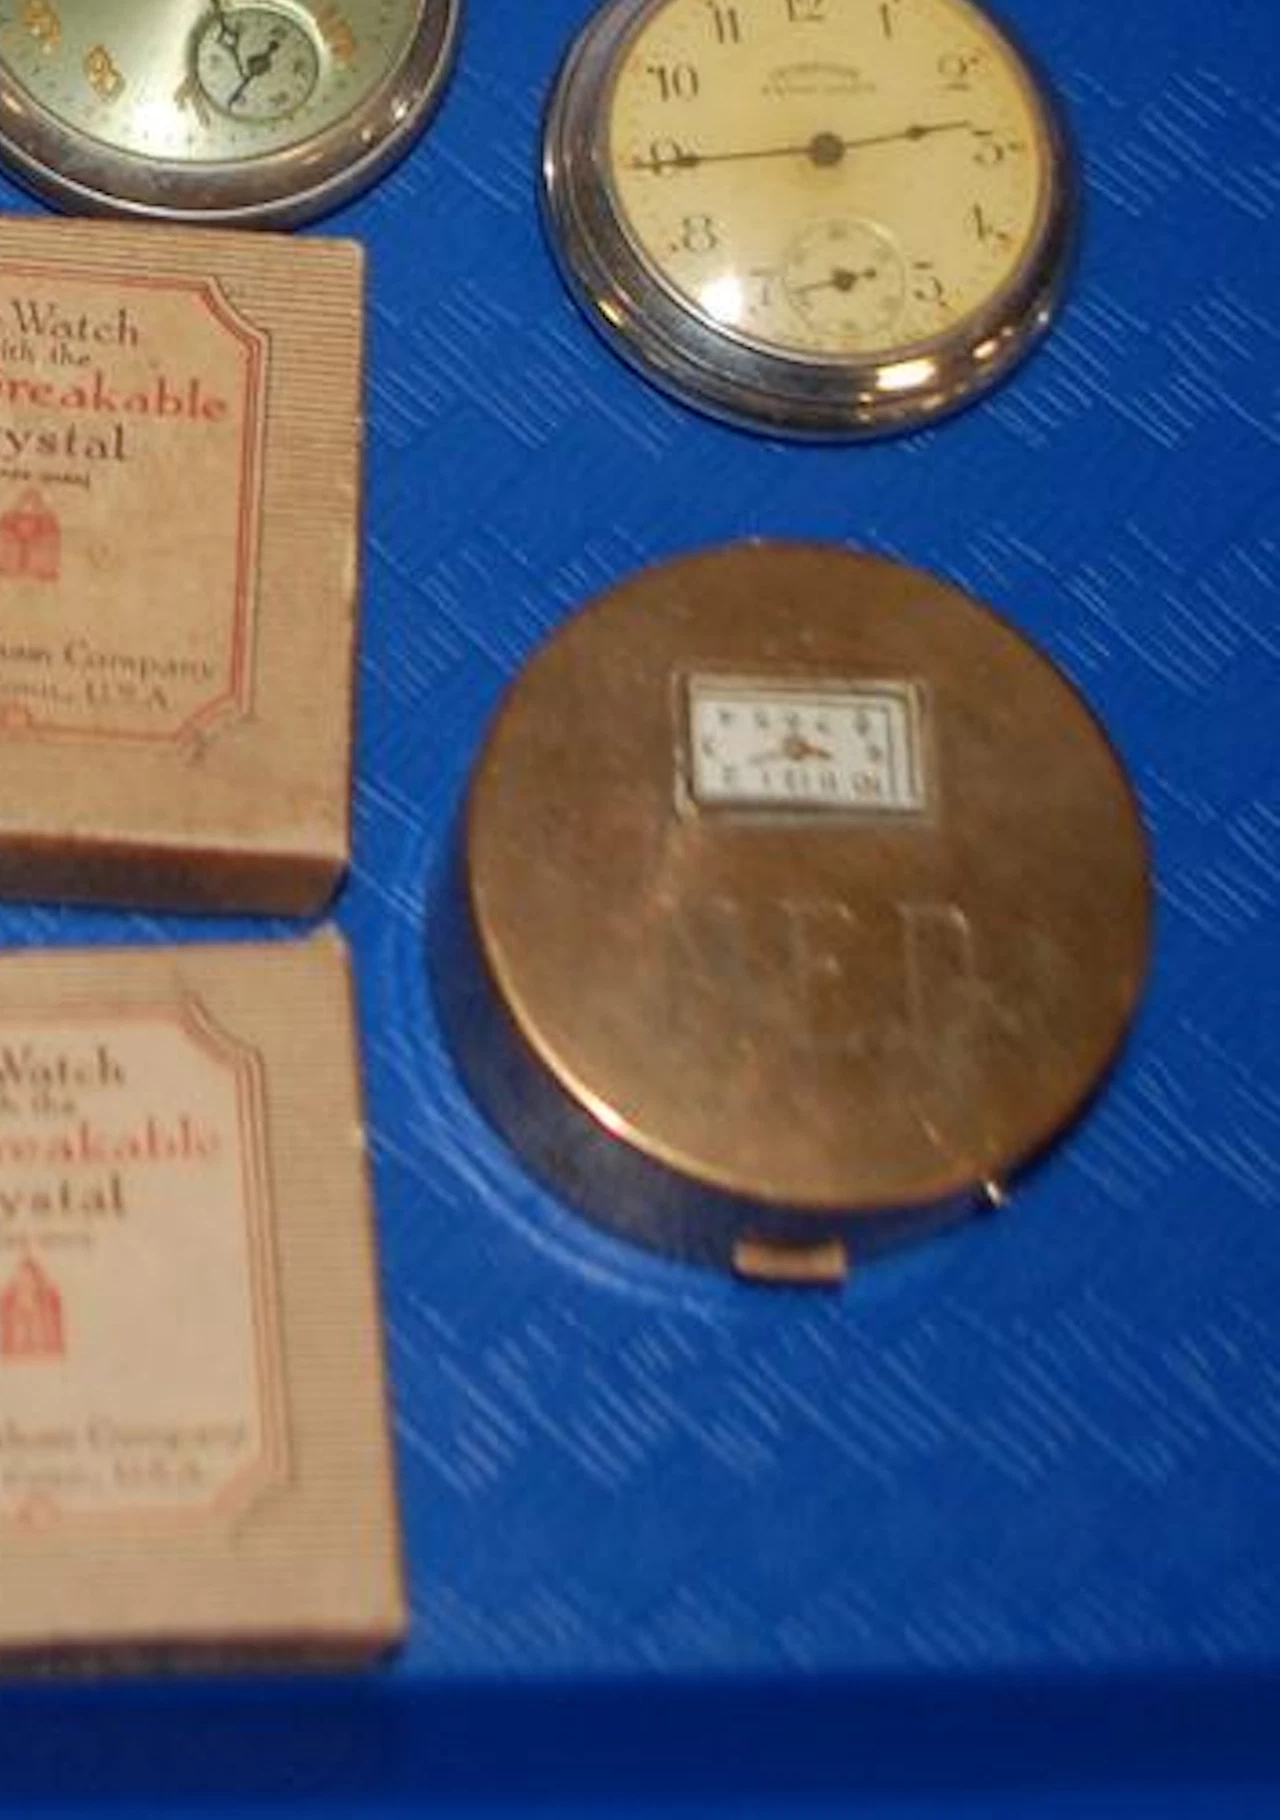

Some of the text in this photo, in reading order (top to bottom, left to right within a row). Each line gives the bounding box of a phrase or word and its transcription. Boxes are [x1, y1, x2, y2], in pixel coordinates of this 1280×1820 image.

[12, 296, 140, 349] Watch
[49, 339, 93, 368] the
[62, 637, 213, 681] Company
